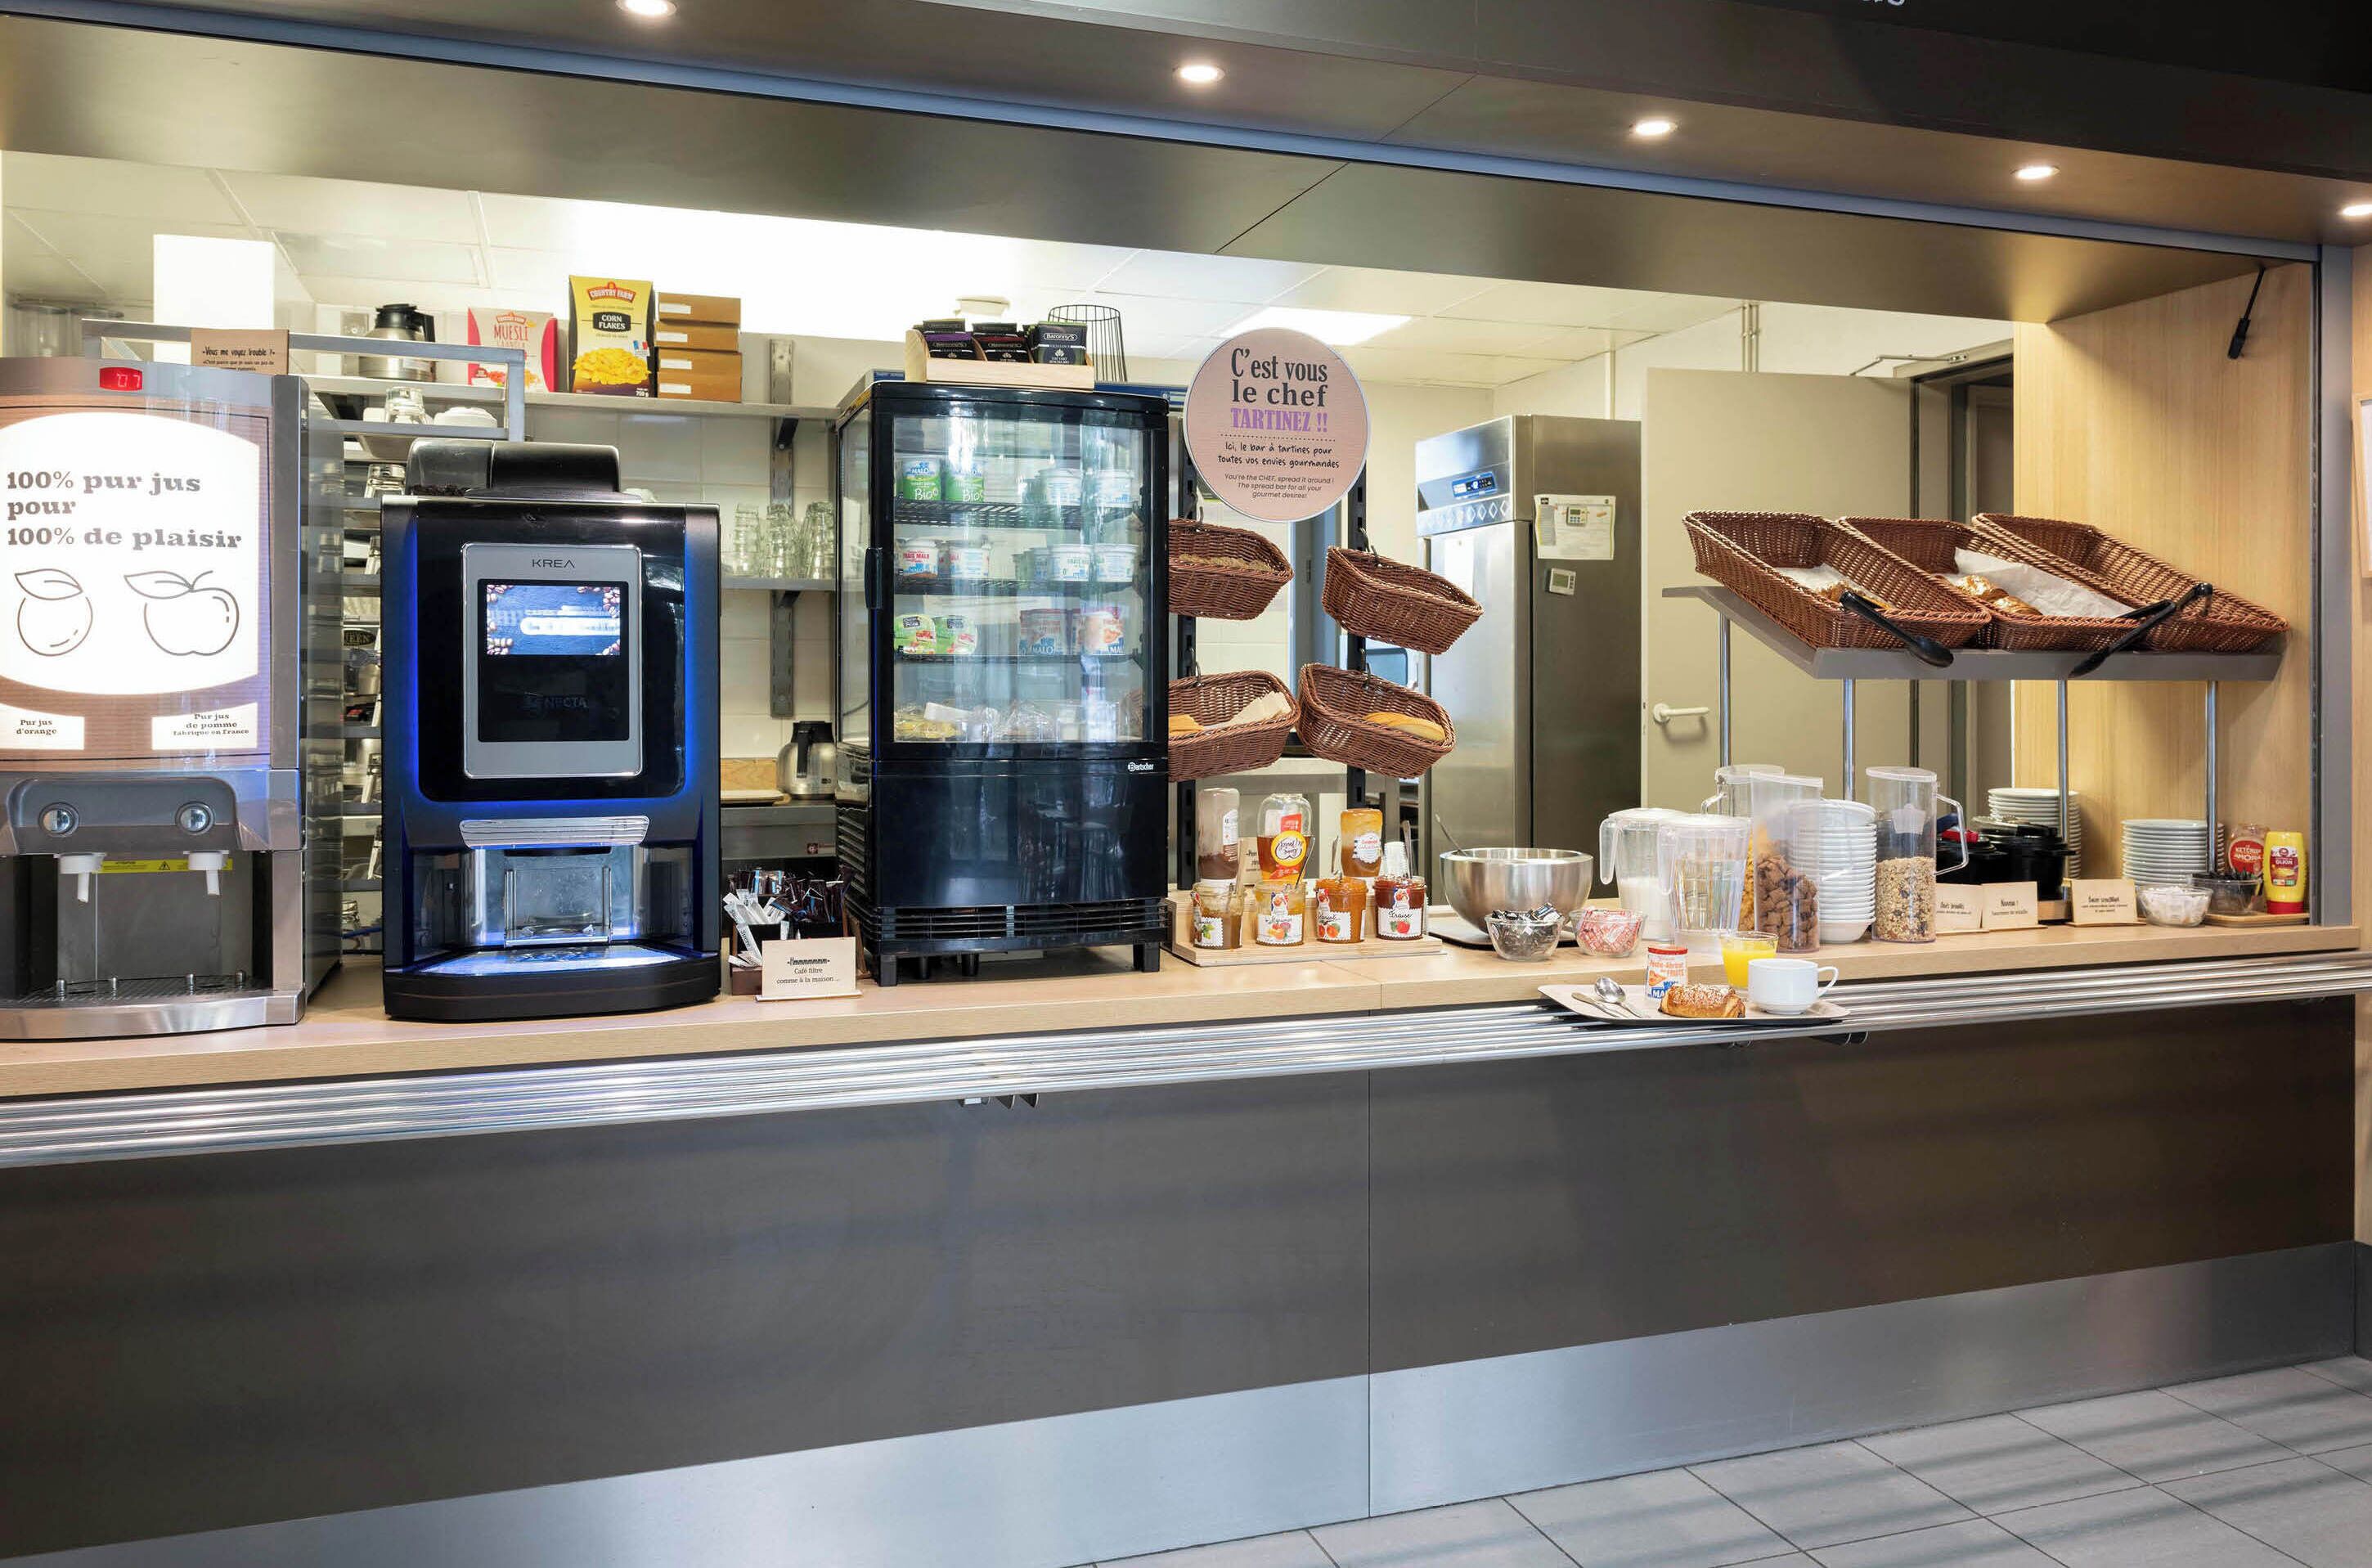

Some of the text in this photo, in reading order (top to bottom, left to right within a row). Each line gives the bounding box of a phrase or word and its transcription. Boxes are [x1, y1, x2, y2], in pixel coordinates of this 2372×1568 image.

[601, 314, 622, 322] CORN
[599, 321, 626, 330] FLAKES
[494, 325, 528, 341] MUESLI
[1231, 348, 1328, 382] C'est vous
[1232, 379, 1328, 407] le chef
[1230, 407, 1328, 433] TARTINEZ !!
[1240, 442, 1247, 452] le
[1250, 443, 1265, 452] bar
[1269, 443, 1274, 452] à
[1278, 443, 1310, 454] tartines
[1313, 447, 1332, 456] pour
[1217, 455, 1340, 469] toutes vos envies gourmandes
[7, 471, 200, 496] 100% pur jus
[1278, 475, 1301, 483] spread
[1251, 483, 1274, 491] spread
[1307, 486, 1322, 494] your
[7, 501, 76, 520] pour
[7, 528, 242, 550] 100% de plaisir
[532, 559, 575, 568] KREA
[214, 712, 229, 721] jus
